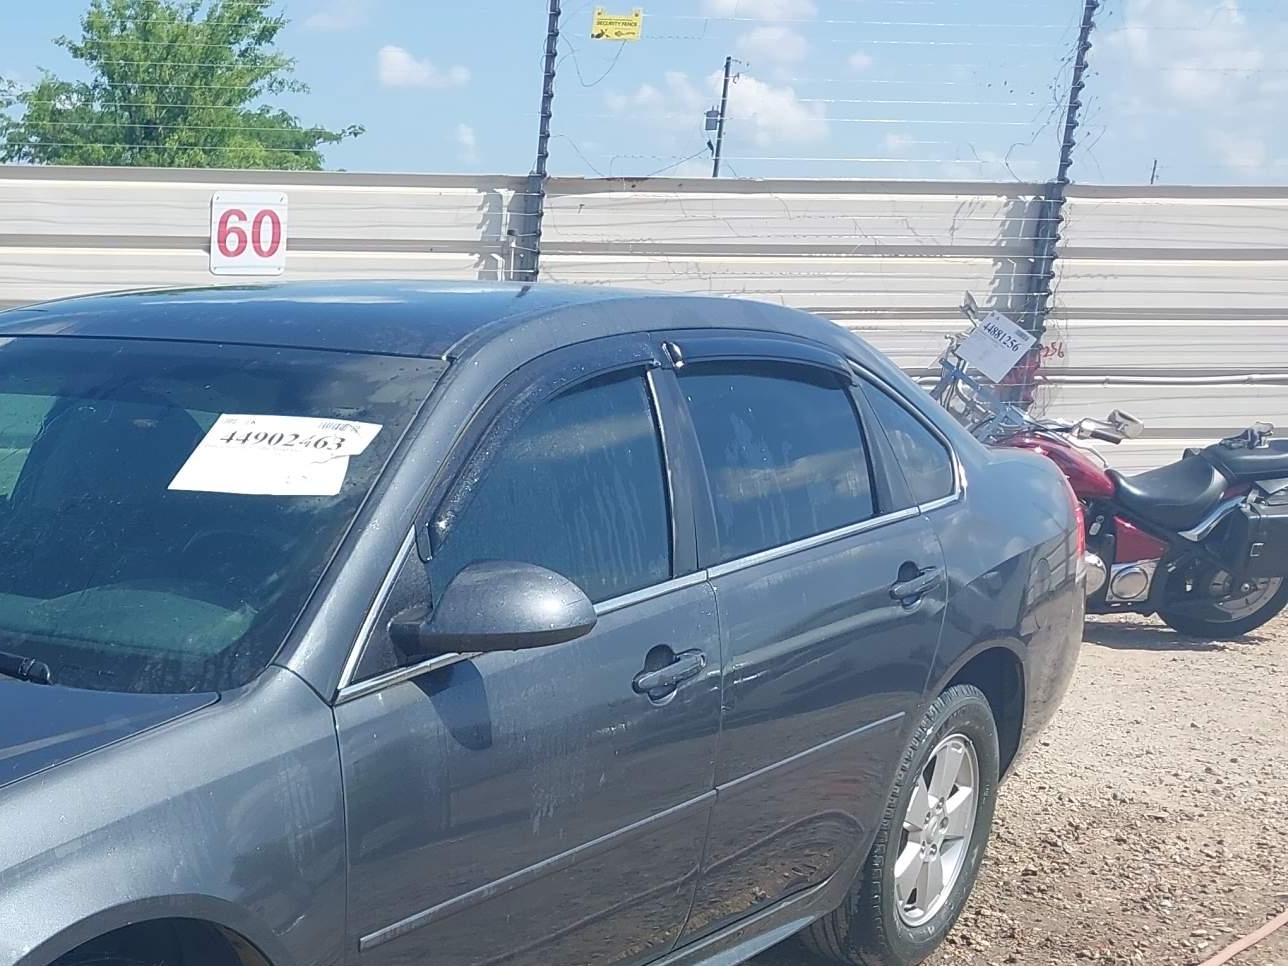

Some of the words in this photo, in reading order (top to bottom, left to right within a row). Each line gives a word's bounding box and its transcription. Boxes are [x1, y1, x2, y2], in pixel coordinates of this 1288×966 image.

[217, 208, 281, 258] 60
[983, 322, 1022, 352] 44881256
[220, 429, 347, 451] 44902463
